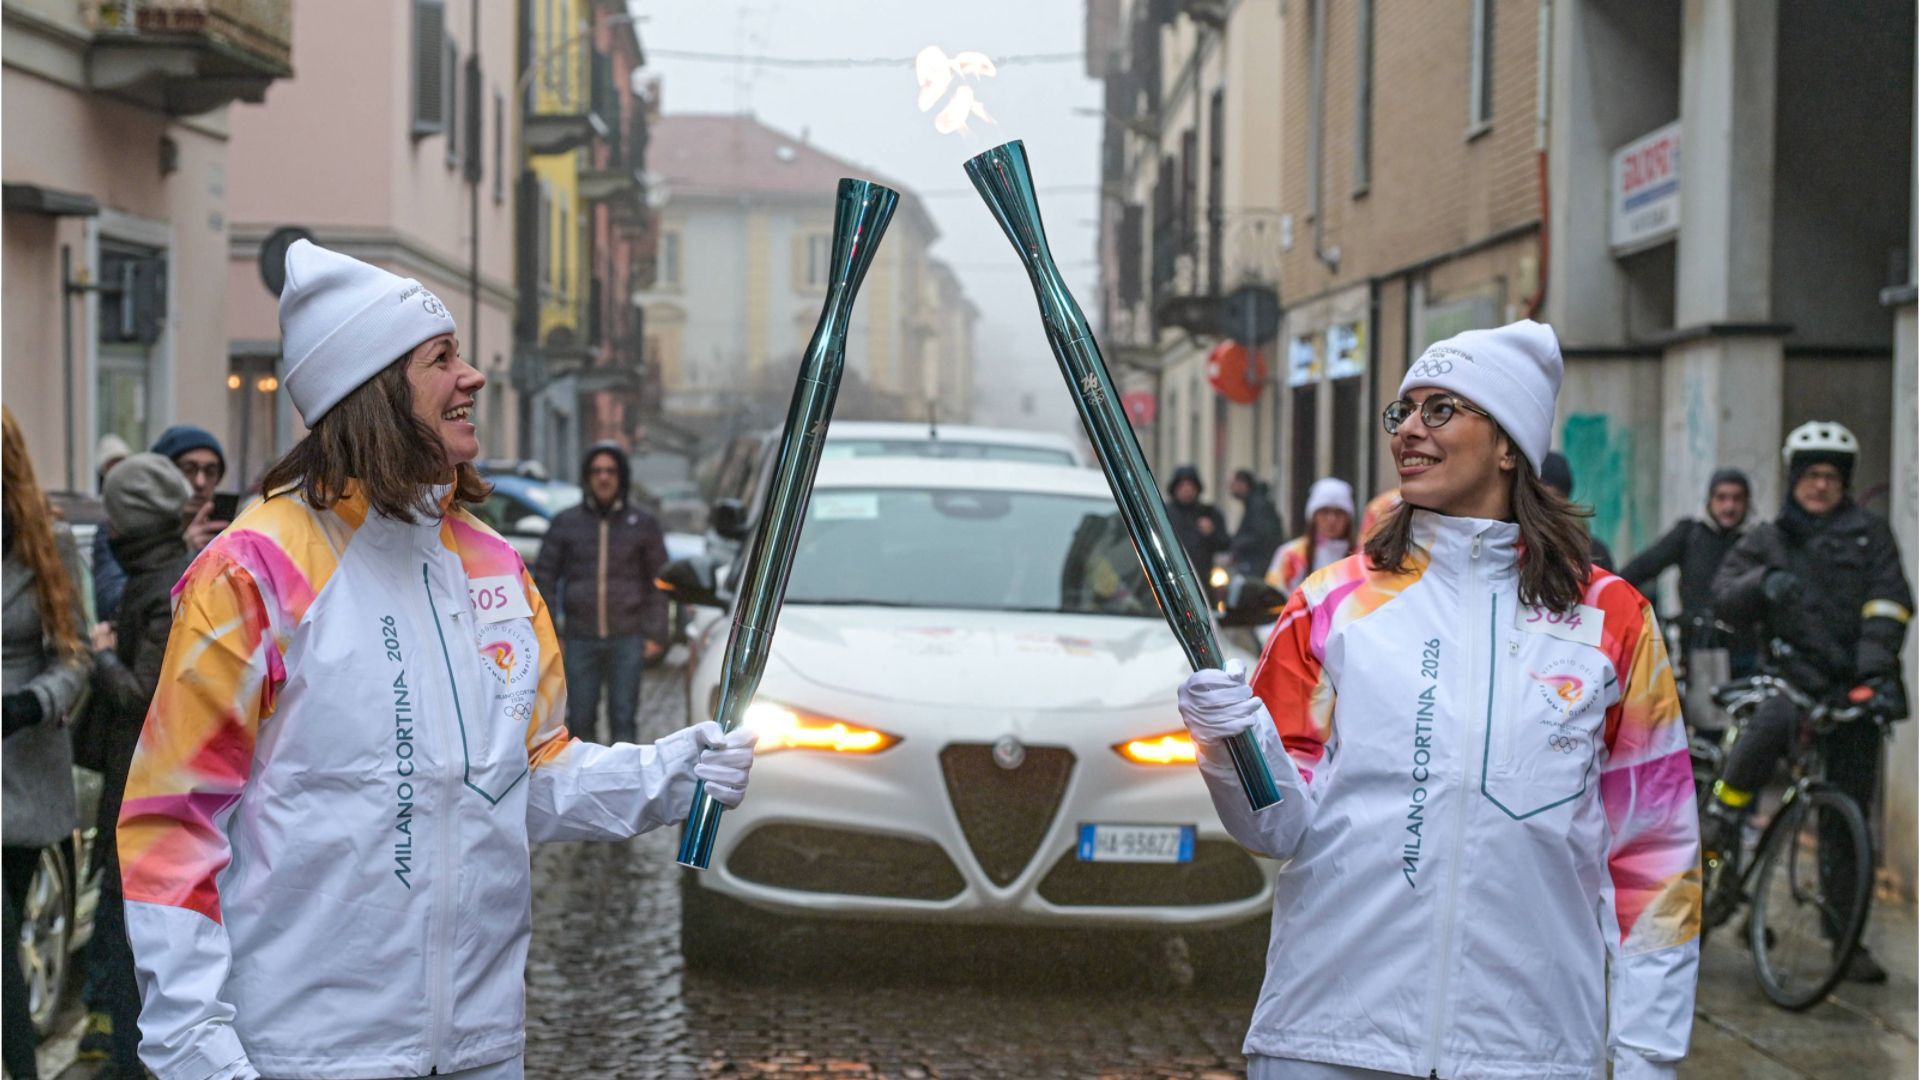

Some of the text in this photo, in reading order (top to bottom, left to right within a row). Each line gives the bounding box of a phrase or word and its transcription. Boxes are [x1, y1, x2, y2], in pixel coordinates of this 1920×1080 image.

[379, 614, 415, 890] MILANO CORTINA 2026
[1402, 638, 1440, 889] MILANO CORTINA 2026
